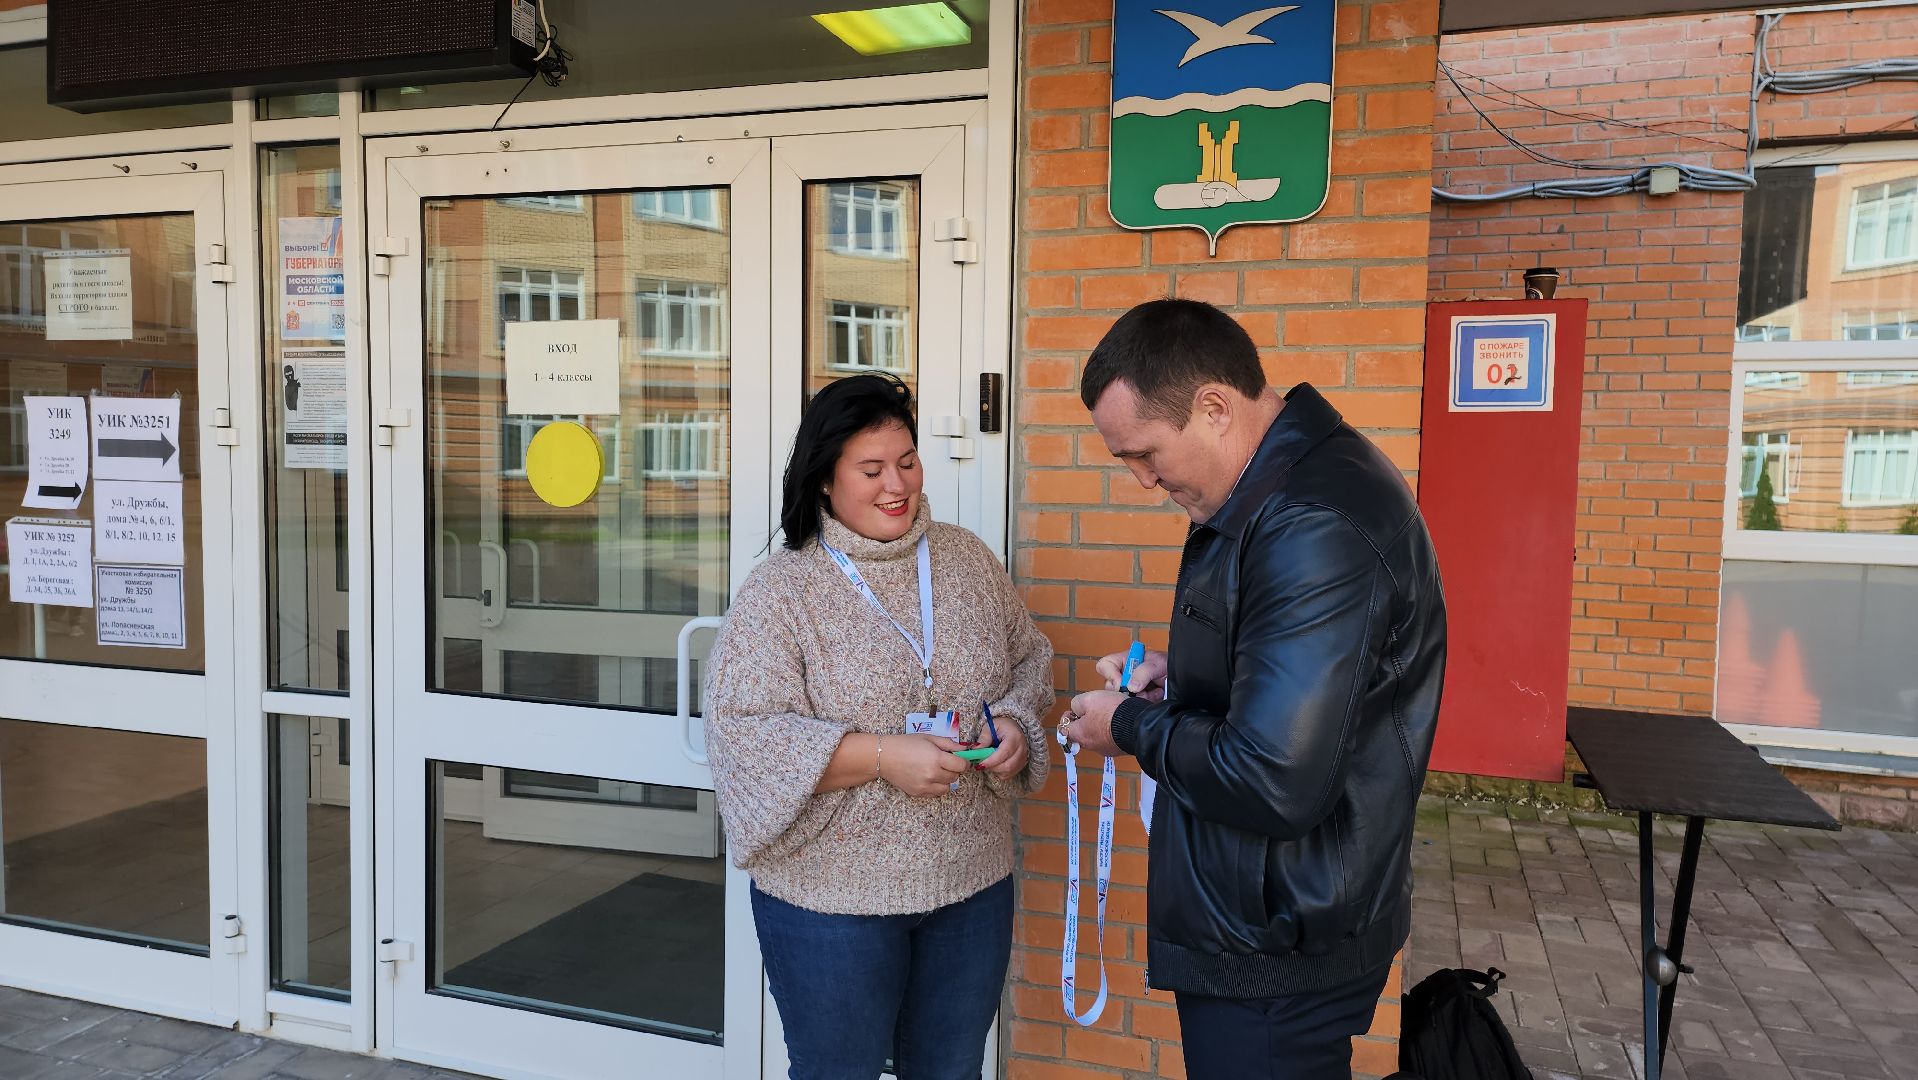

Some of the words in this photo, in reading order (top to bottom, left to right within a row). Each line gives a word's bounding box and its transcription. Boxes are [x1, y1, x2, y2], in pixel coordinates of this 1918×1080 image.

[288, 276, 343, 284] МОСКОВСКОЙ
[548, 344, 577, 353] ВХОД
[534, 373, 538, 381] 1
[548, 373, 554, 382] 4
[557, 374, 592, 382] классы
[48, 408, 72, 419] УИК
[98, 415, 126, 428] УИК
[130, 415, 170, 429] №3251
[49, 429, 71, 440] 3249
[112, 499, 124, 509] ул.
[127, 497, 168, 510] Дружбы,
[129, 515, 138, 524] №
[140, 516, 148, 525] 4,
[150, 516, 157, 526] 6,
[160, 516, 174, 526] 6/1,
[24, 531, 44, 540] УИК
[46, 533, 55, 541] №
[58, 533, 76, 542] 3252
[105, 530, 119, 540] 8/1,
[122, 531, 136, 540] 8/2,
[140, 532, 150, 541] 10,
[153, 532, 163, 542] 12,
[167, 533, 176, 542] 15
[40, 547, 66, 556] Дружбы
